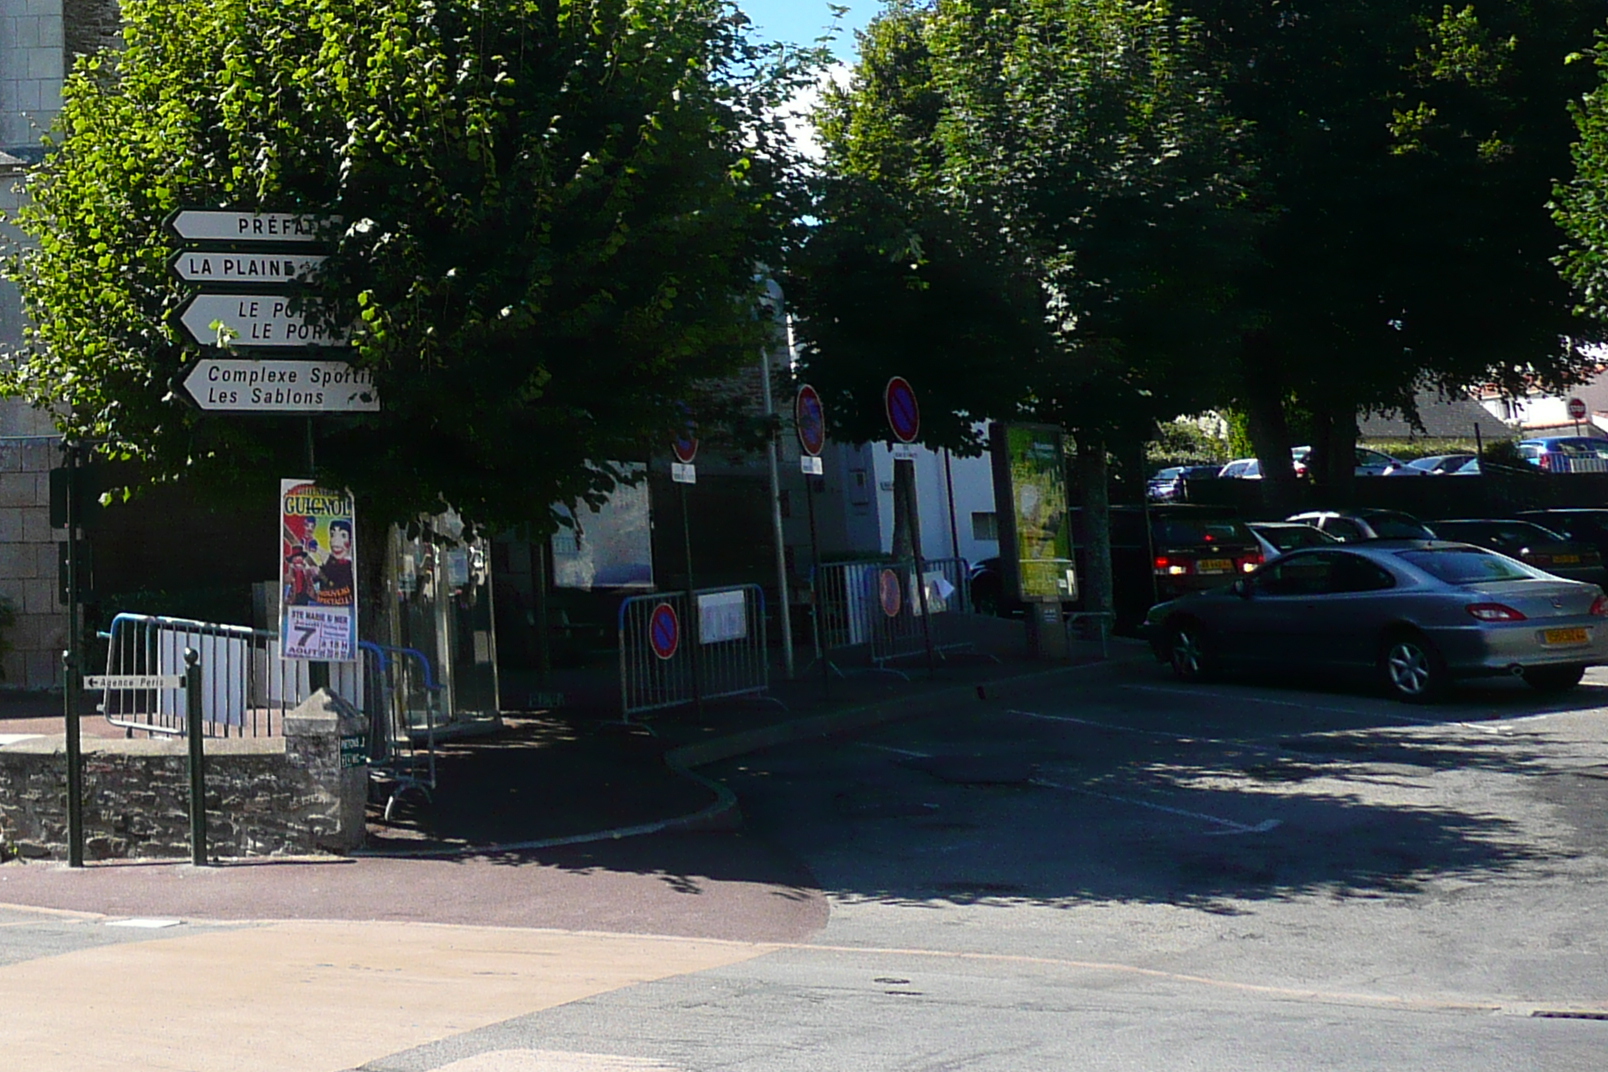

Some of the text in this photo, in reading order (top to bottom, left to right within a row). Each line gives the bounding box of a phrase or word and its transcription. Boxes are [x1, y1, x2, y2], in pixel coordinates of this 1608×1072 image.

[190, 258, 212, 275] LA
[223, 259, 295, 276] PLAINE
[238, 301, 259, 318] LE
[251, 322, 272, 339] LE
[208, 365, 297, 386] Complexe
[208, 387, 324, 405] Les Sablons
[284, 496, 352, 517] GUIGNOL
[294, 625, 317, 647] 7
